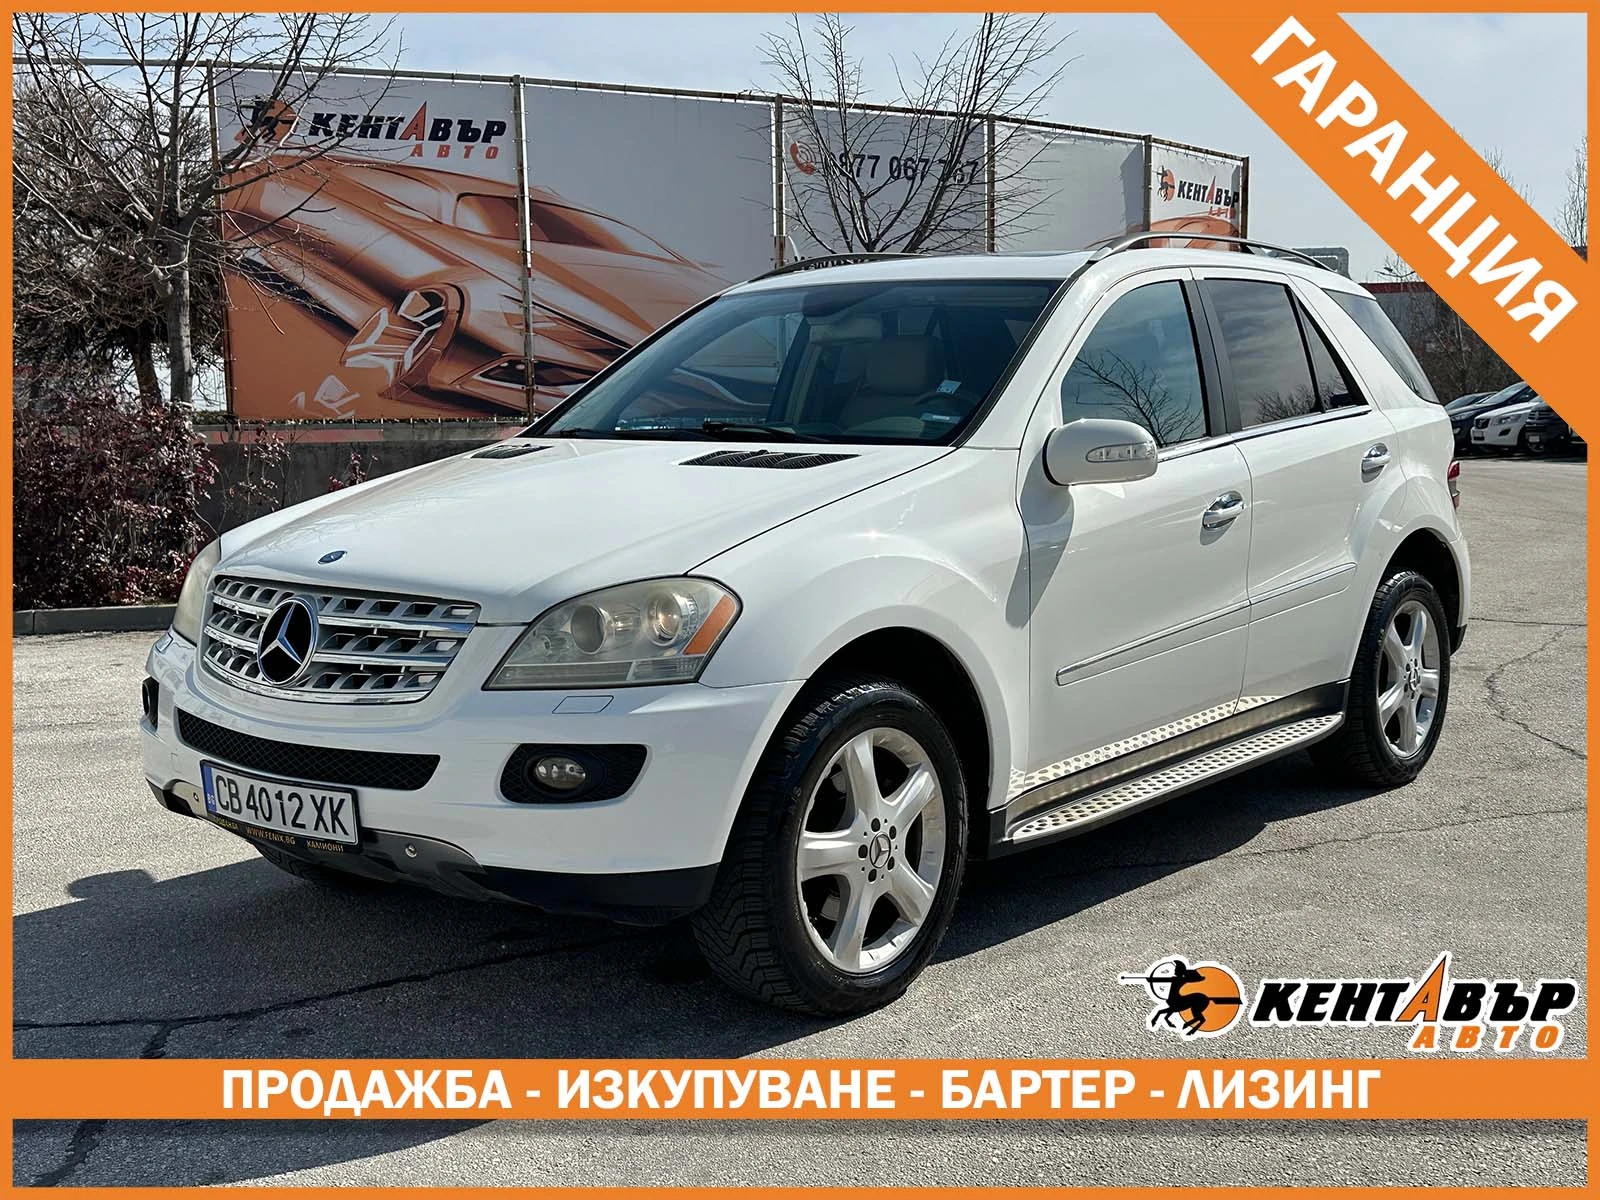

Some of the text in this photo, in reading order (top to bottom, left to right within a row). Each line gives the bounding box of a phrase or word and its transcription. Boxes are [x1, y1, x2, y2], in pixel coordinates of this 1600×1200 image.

[308, 100, 507, 143] КЕНТАВЪР
[410, 143, 499, 159] АВТО
[889, 156, 930, 181] 067
[1177, 175, 1240, 208] КЕНТАВЪР
[245, 828, 296, 845] WWW.FENIX.BG
[306, 840, 344, 852] КАМИОНИ
